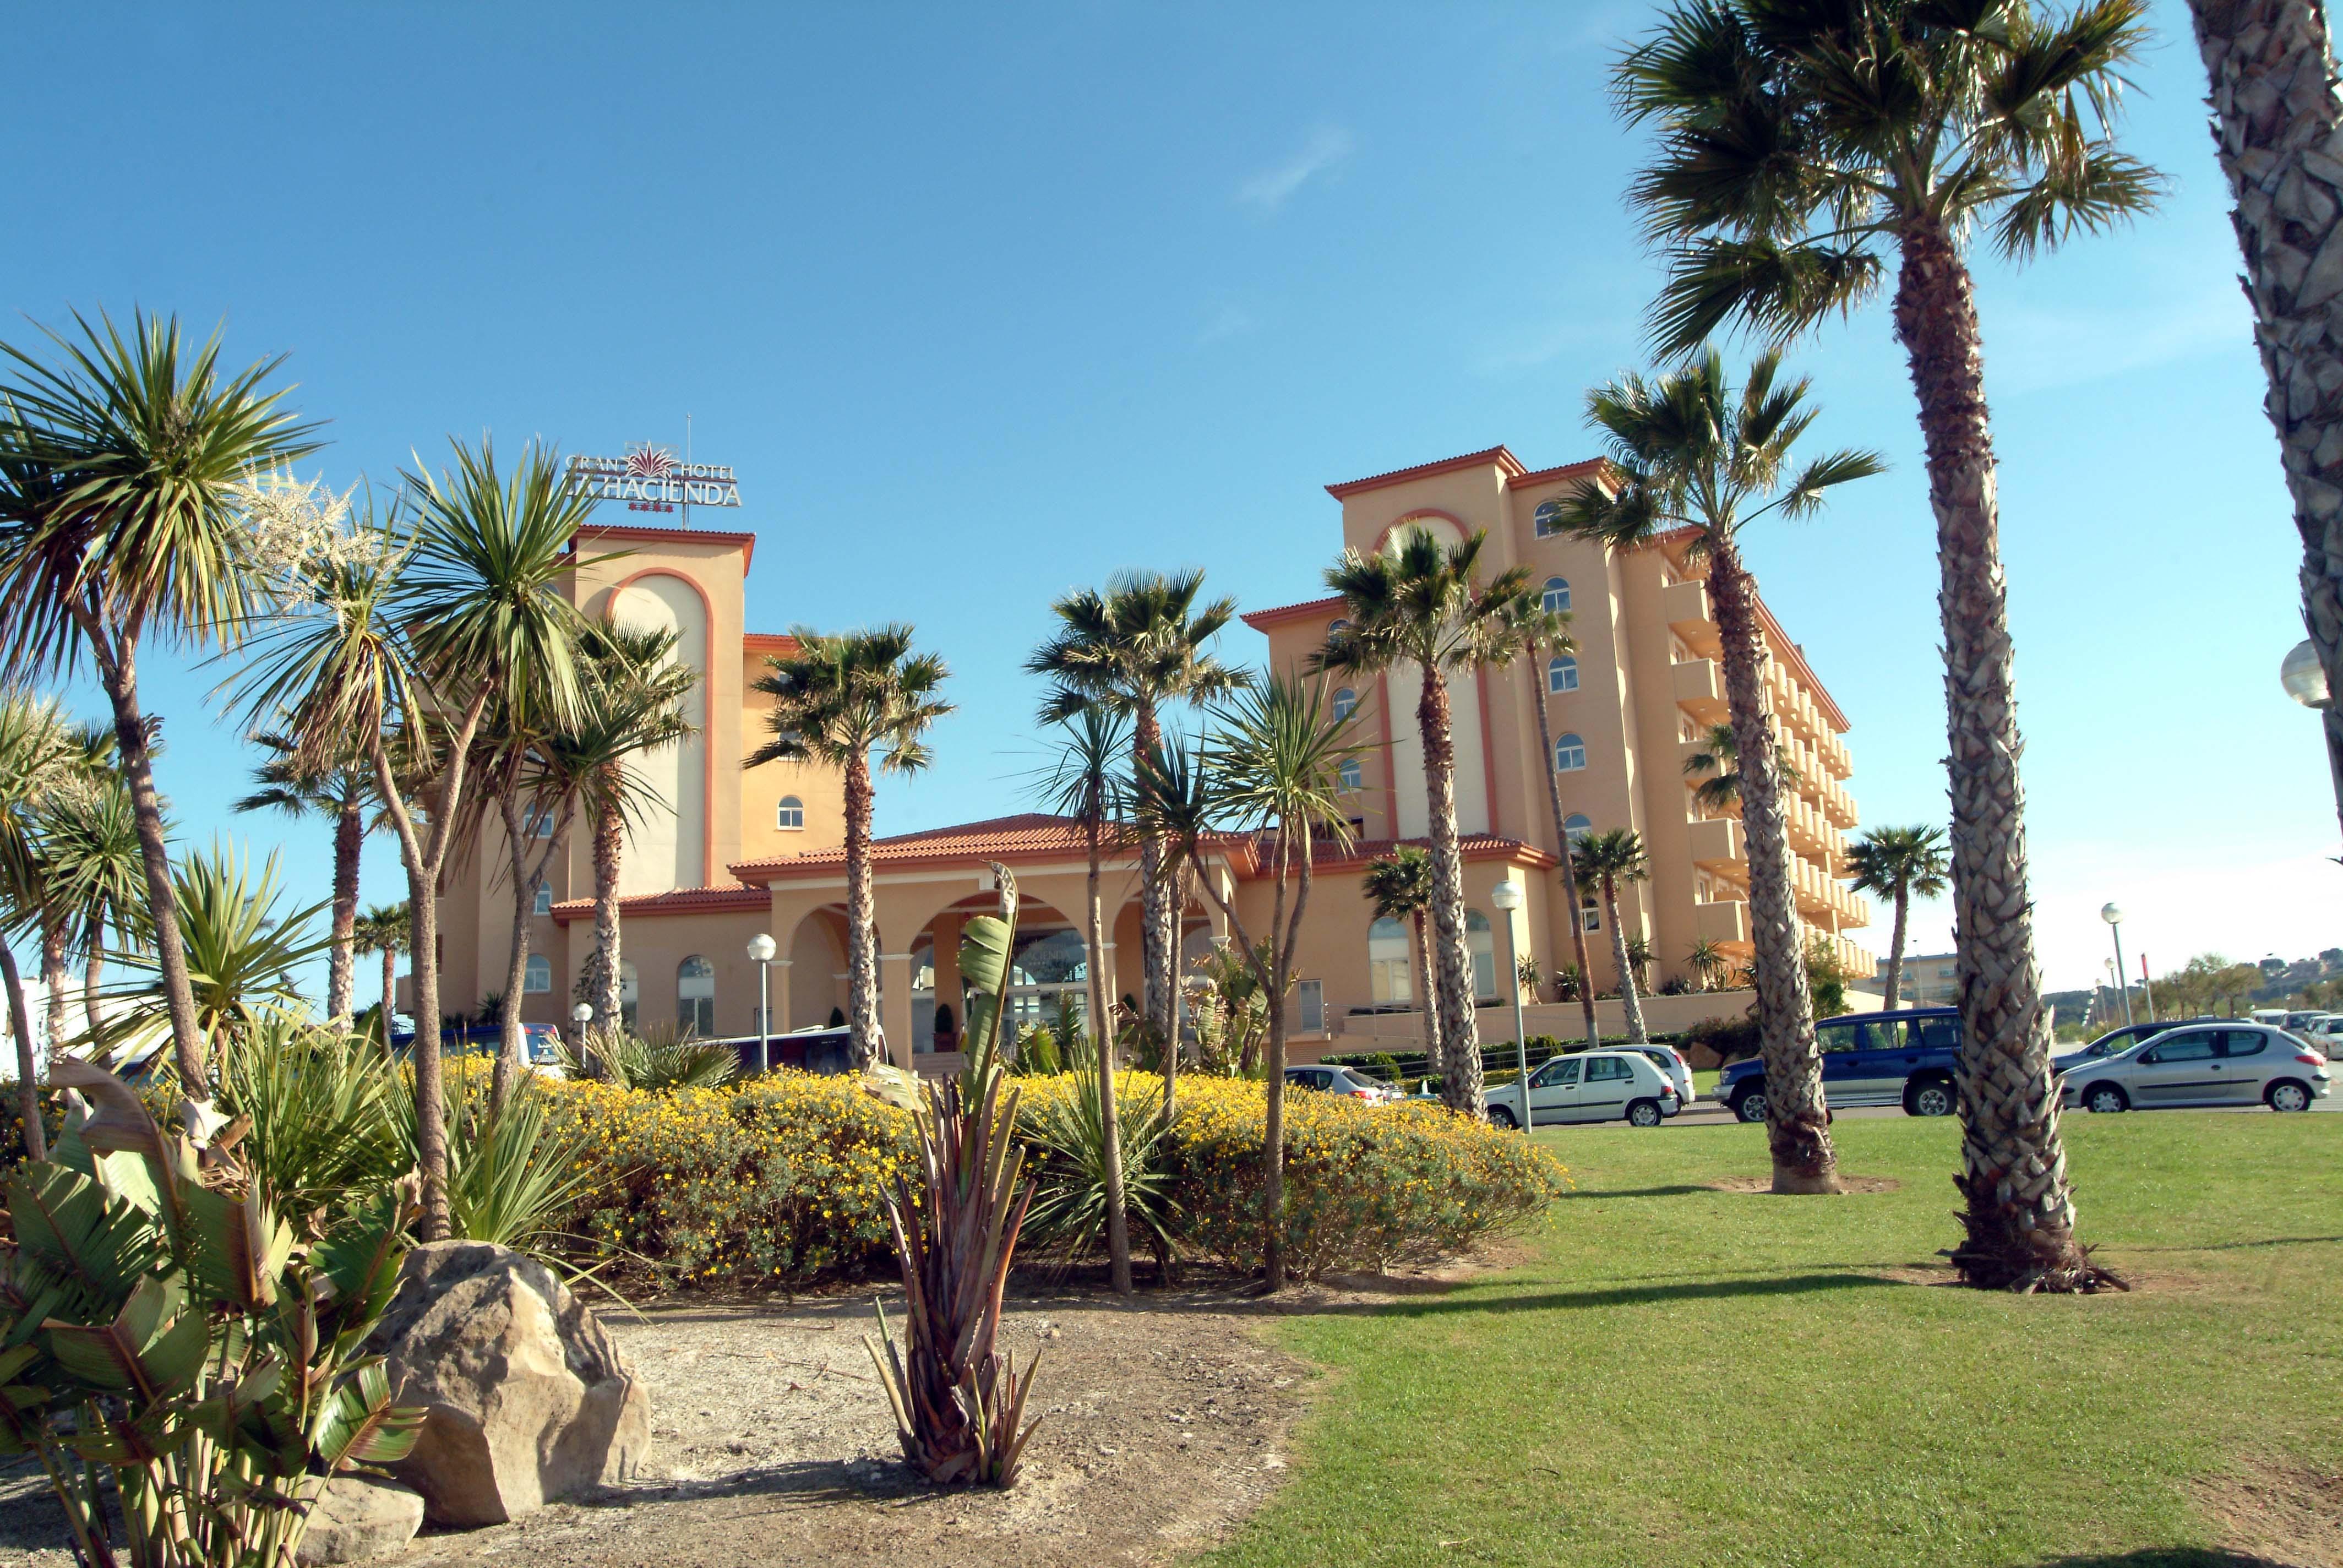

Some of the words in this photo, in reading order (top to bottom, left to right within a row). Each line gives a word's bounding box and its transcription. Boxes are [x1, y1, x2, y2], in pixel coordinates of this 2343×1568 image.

[565, 455, 618, 471] GRAN
[681, 464, 737, 480] HOTEL
[604, 476, 742, 507] HACIENDA
